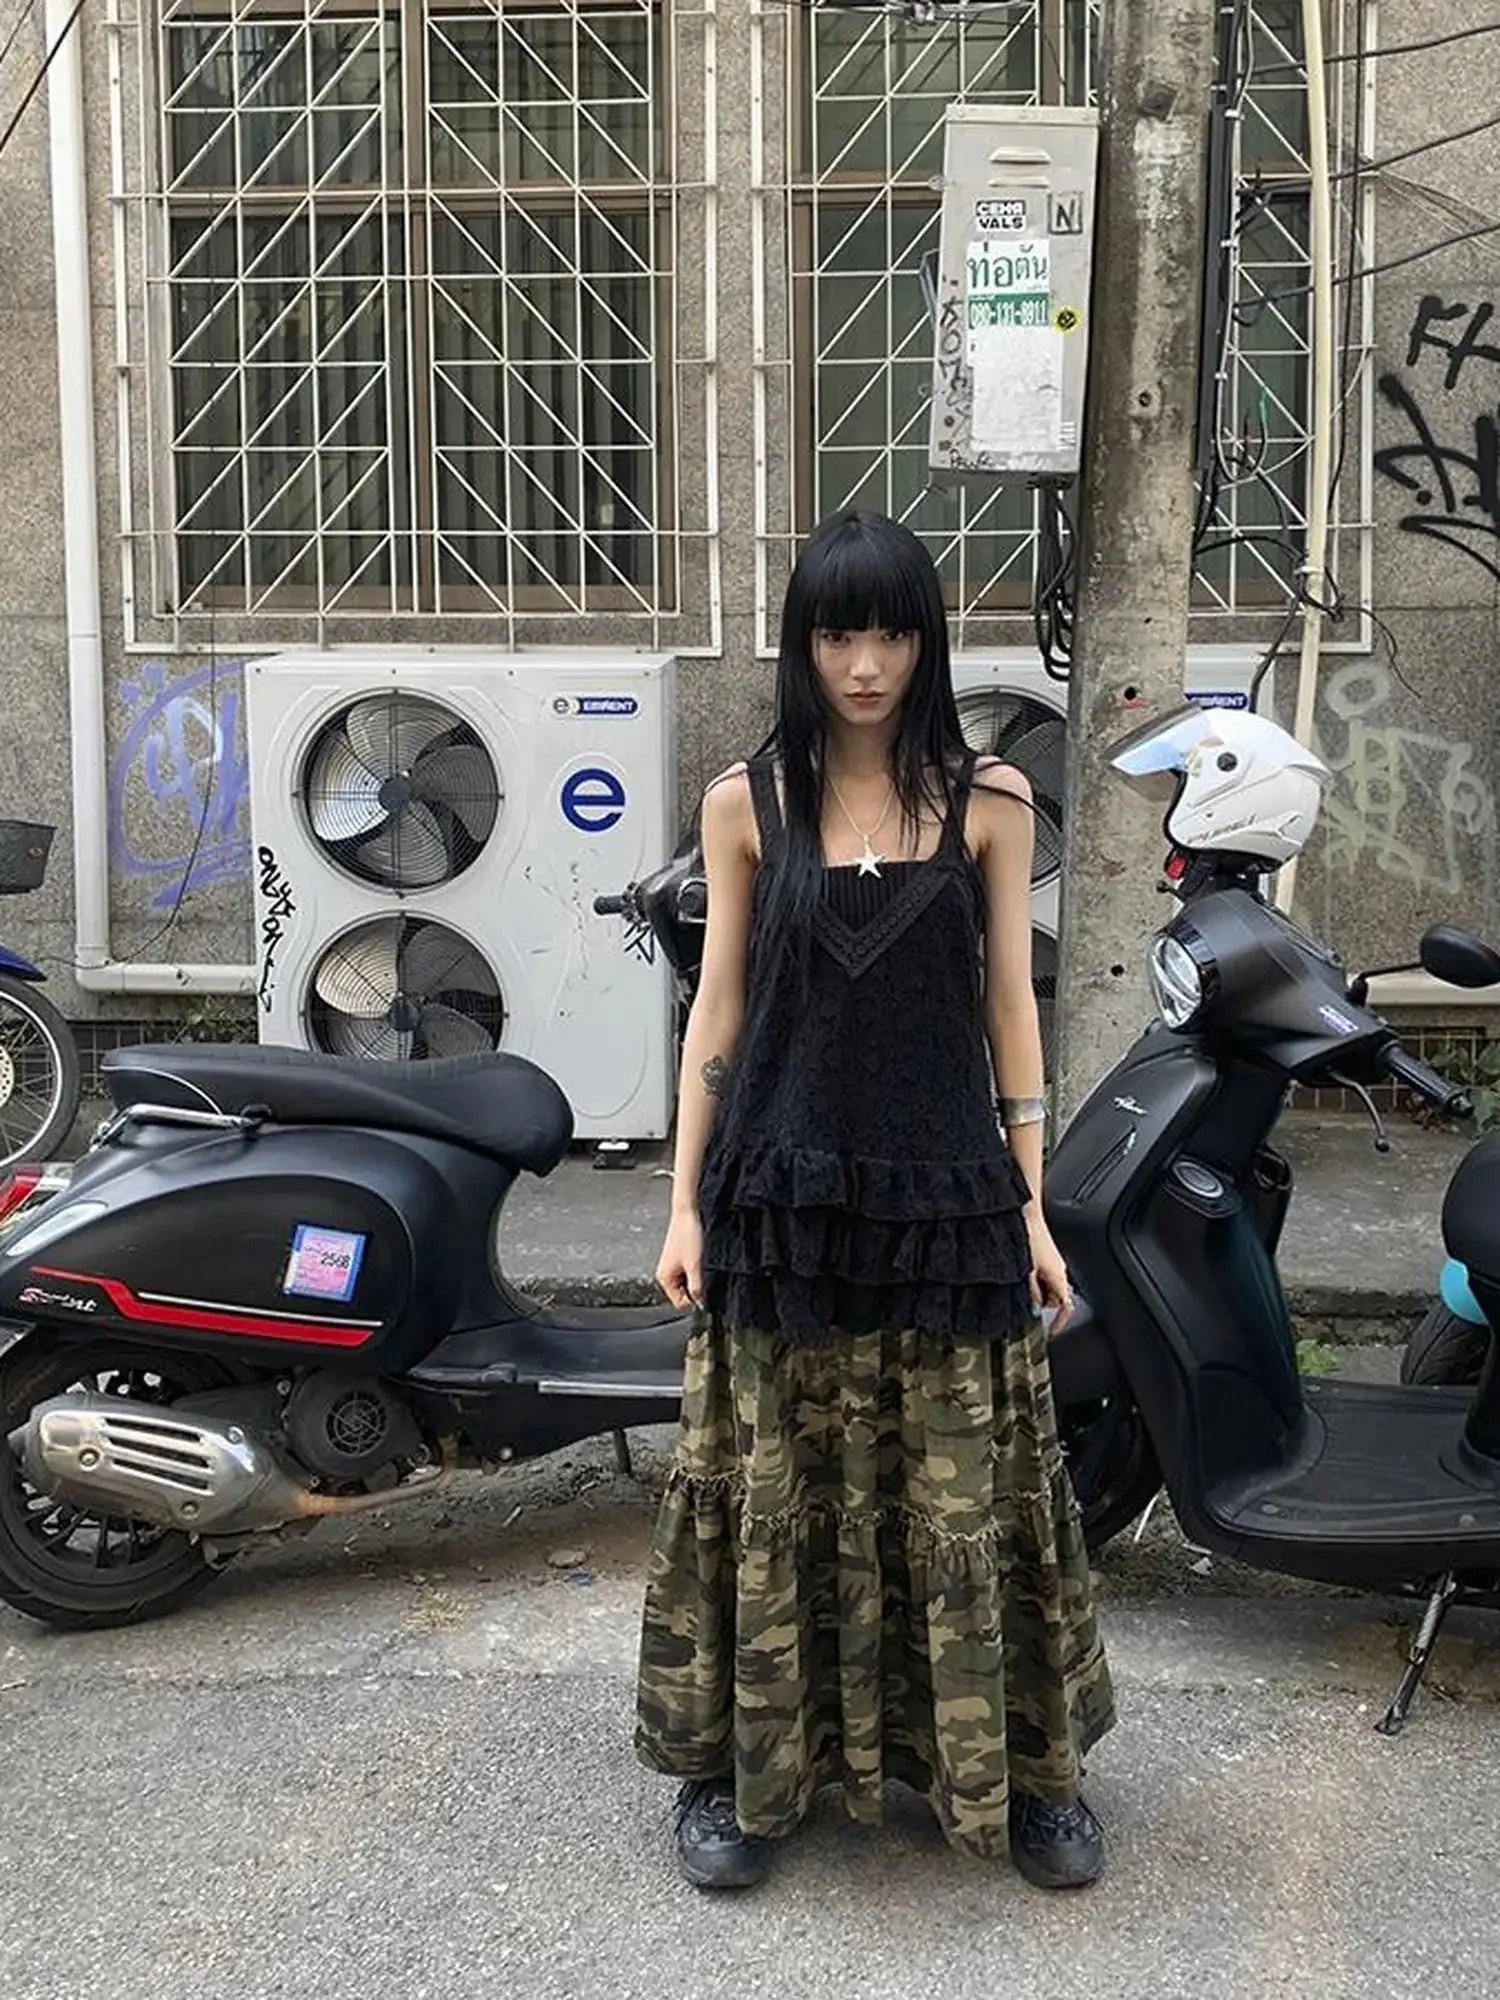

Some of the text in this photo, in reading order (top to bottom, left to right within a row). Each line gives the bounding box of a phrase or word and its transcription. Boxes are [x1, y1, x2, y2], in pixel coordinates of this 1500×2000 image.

[978, 216, 1024, 230] VALS
[966, 241, 1048, 288] ท่อตัน
[561, 768, 625, 832] e
[321, 1252, 349, 1269] 2568
